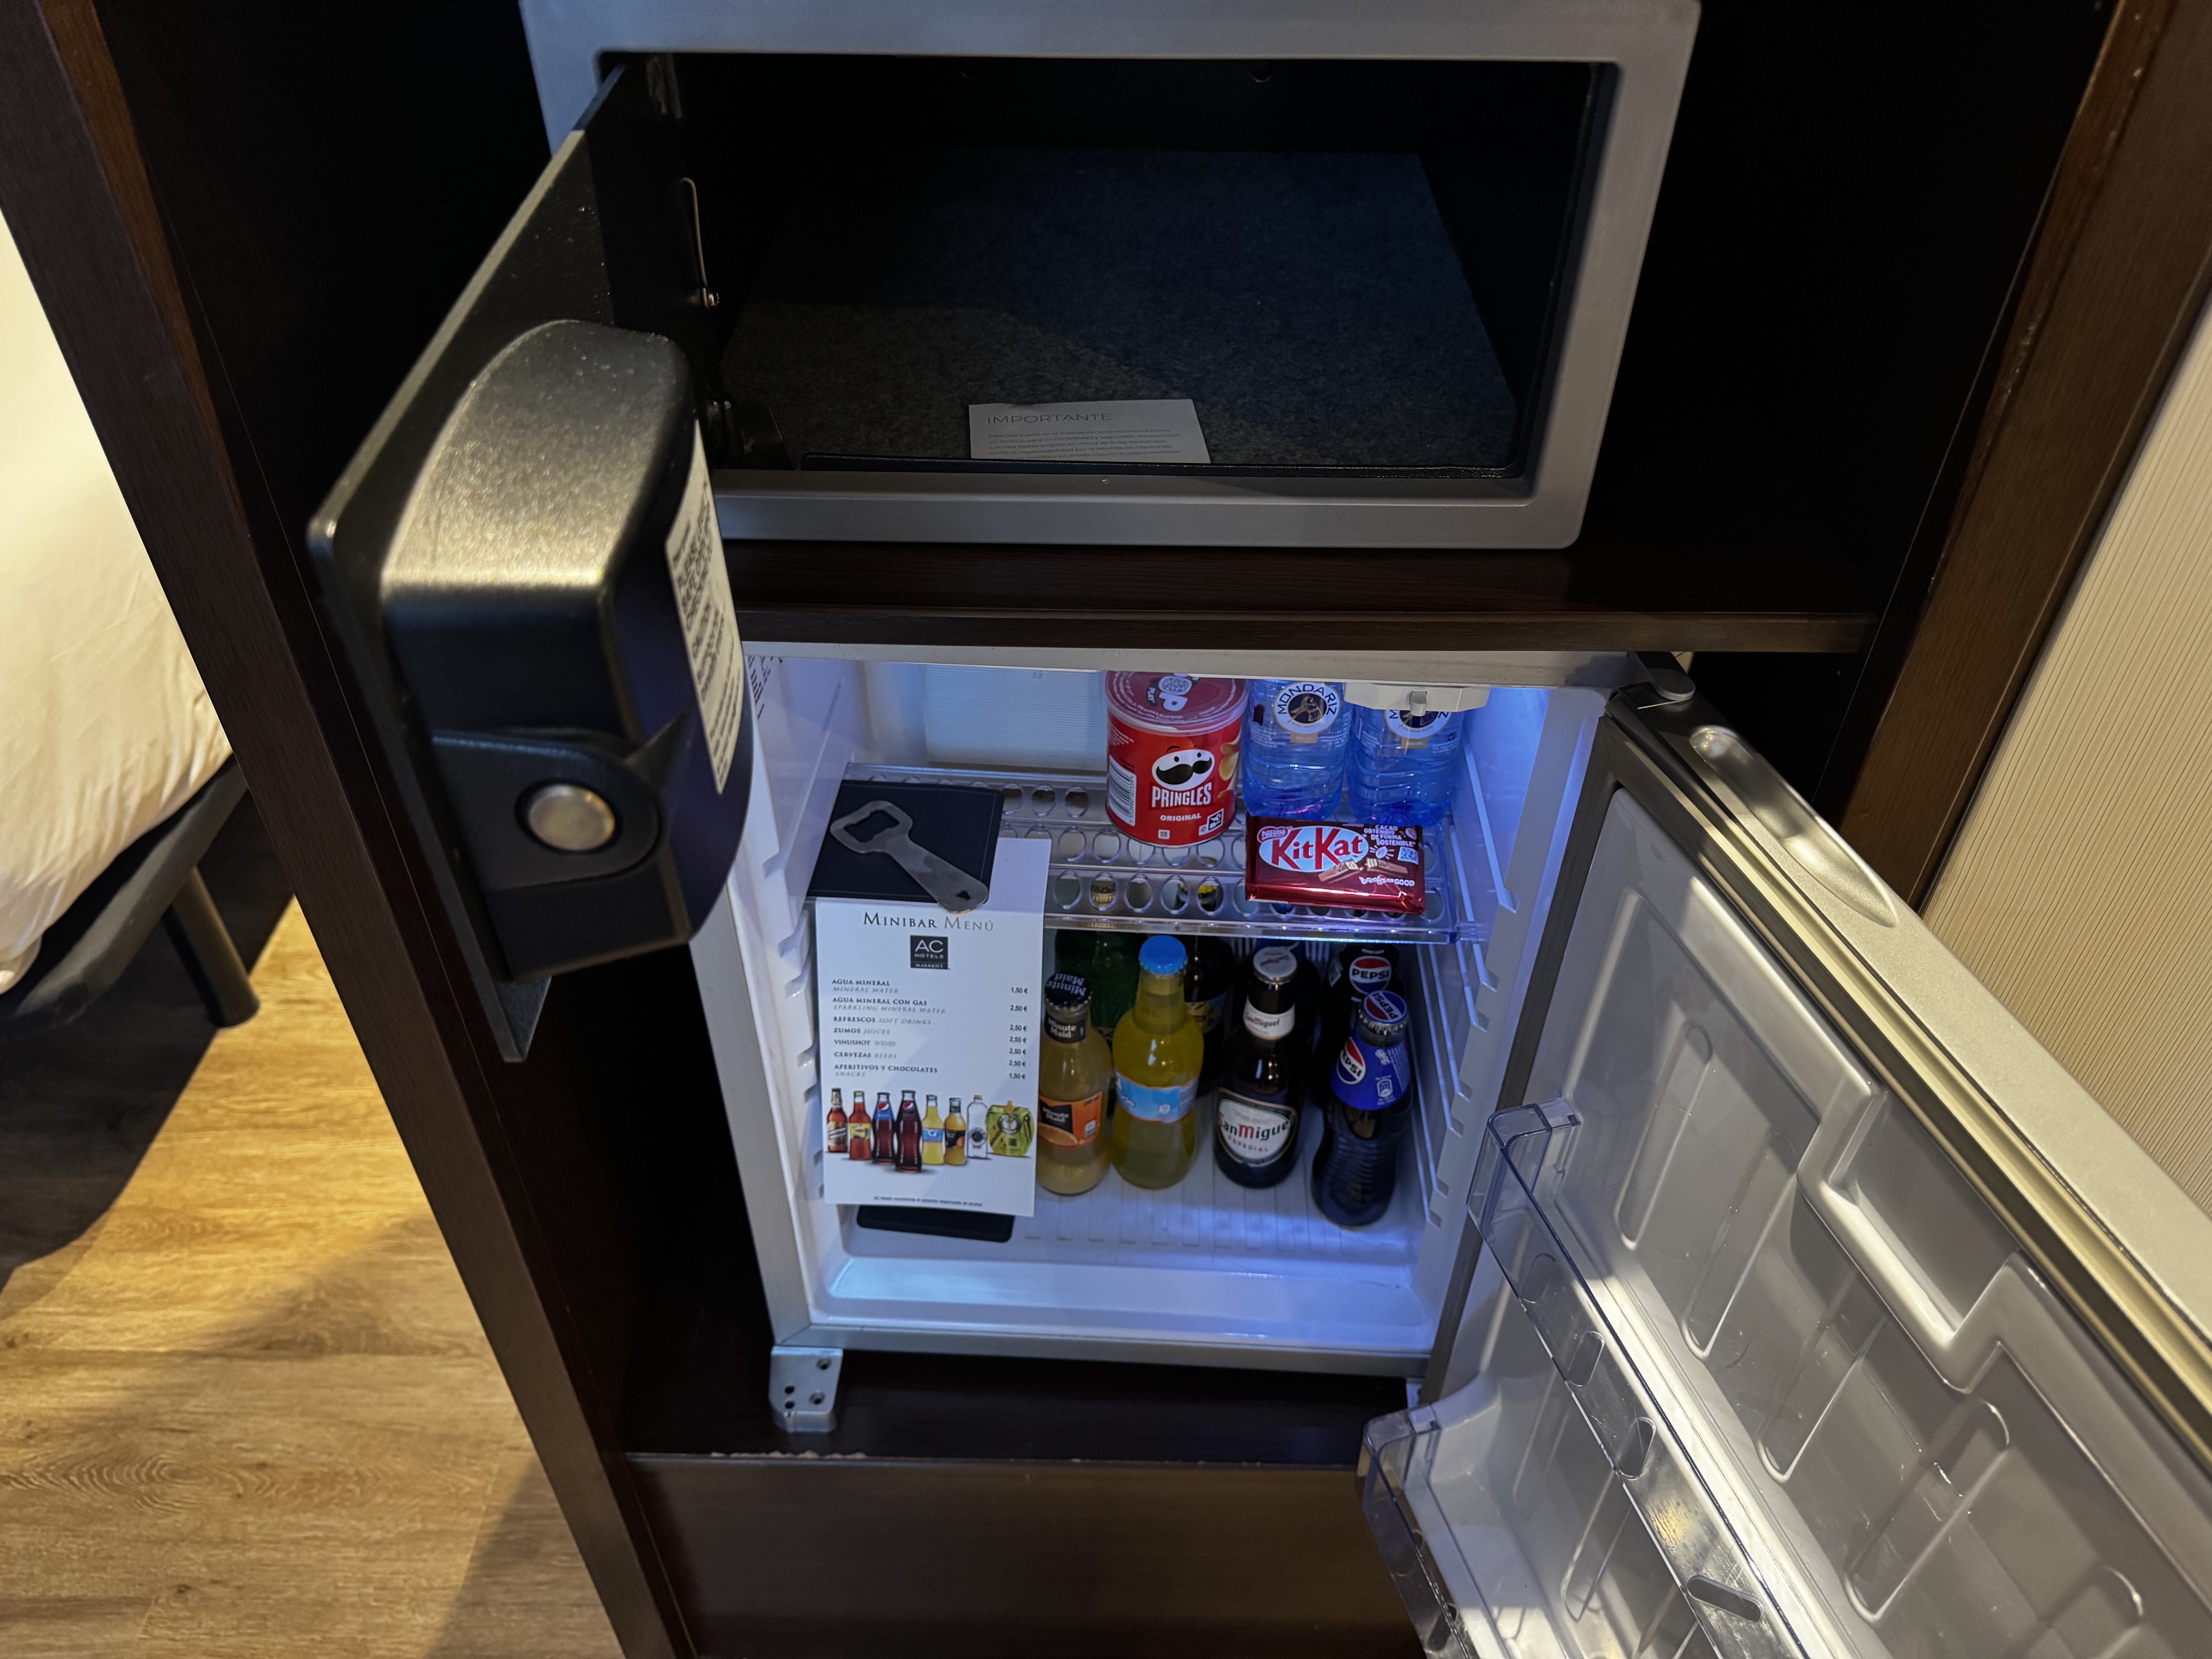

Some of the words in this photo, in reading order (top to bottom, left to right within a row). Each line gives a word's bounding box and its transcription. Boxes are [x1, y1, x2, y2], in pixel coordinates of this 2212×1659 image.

[988, 413, 1113, 424] IMPORTANTE
[1278, 684, 1337, 716] MONDARIZ
[1151, 782, 1212, 809] PRINGLES
[1159, 812, 1202, 822] ORIGINAL
[1271, 827, 1363, 870] KitKat
[1394, 878, 1415, 887] GOOD
[915, 939, 944, 953] AC
[1055, 973, 1085, 986] Maid
[1352, 968, 1389, 979] PEPSI
[1046, 980, 1087, 997] Minute
[1373, 993, 1398, 1019] PEPSI
[1048, 1017, 1077, 1031] Minute
[1227, 1134, 1269, 1152] ESPECIAL
